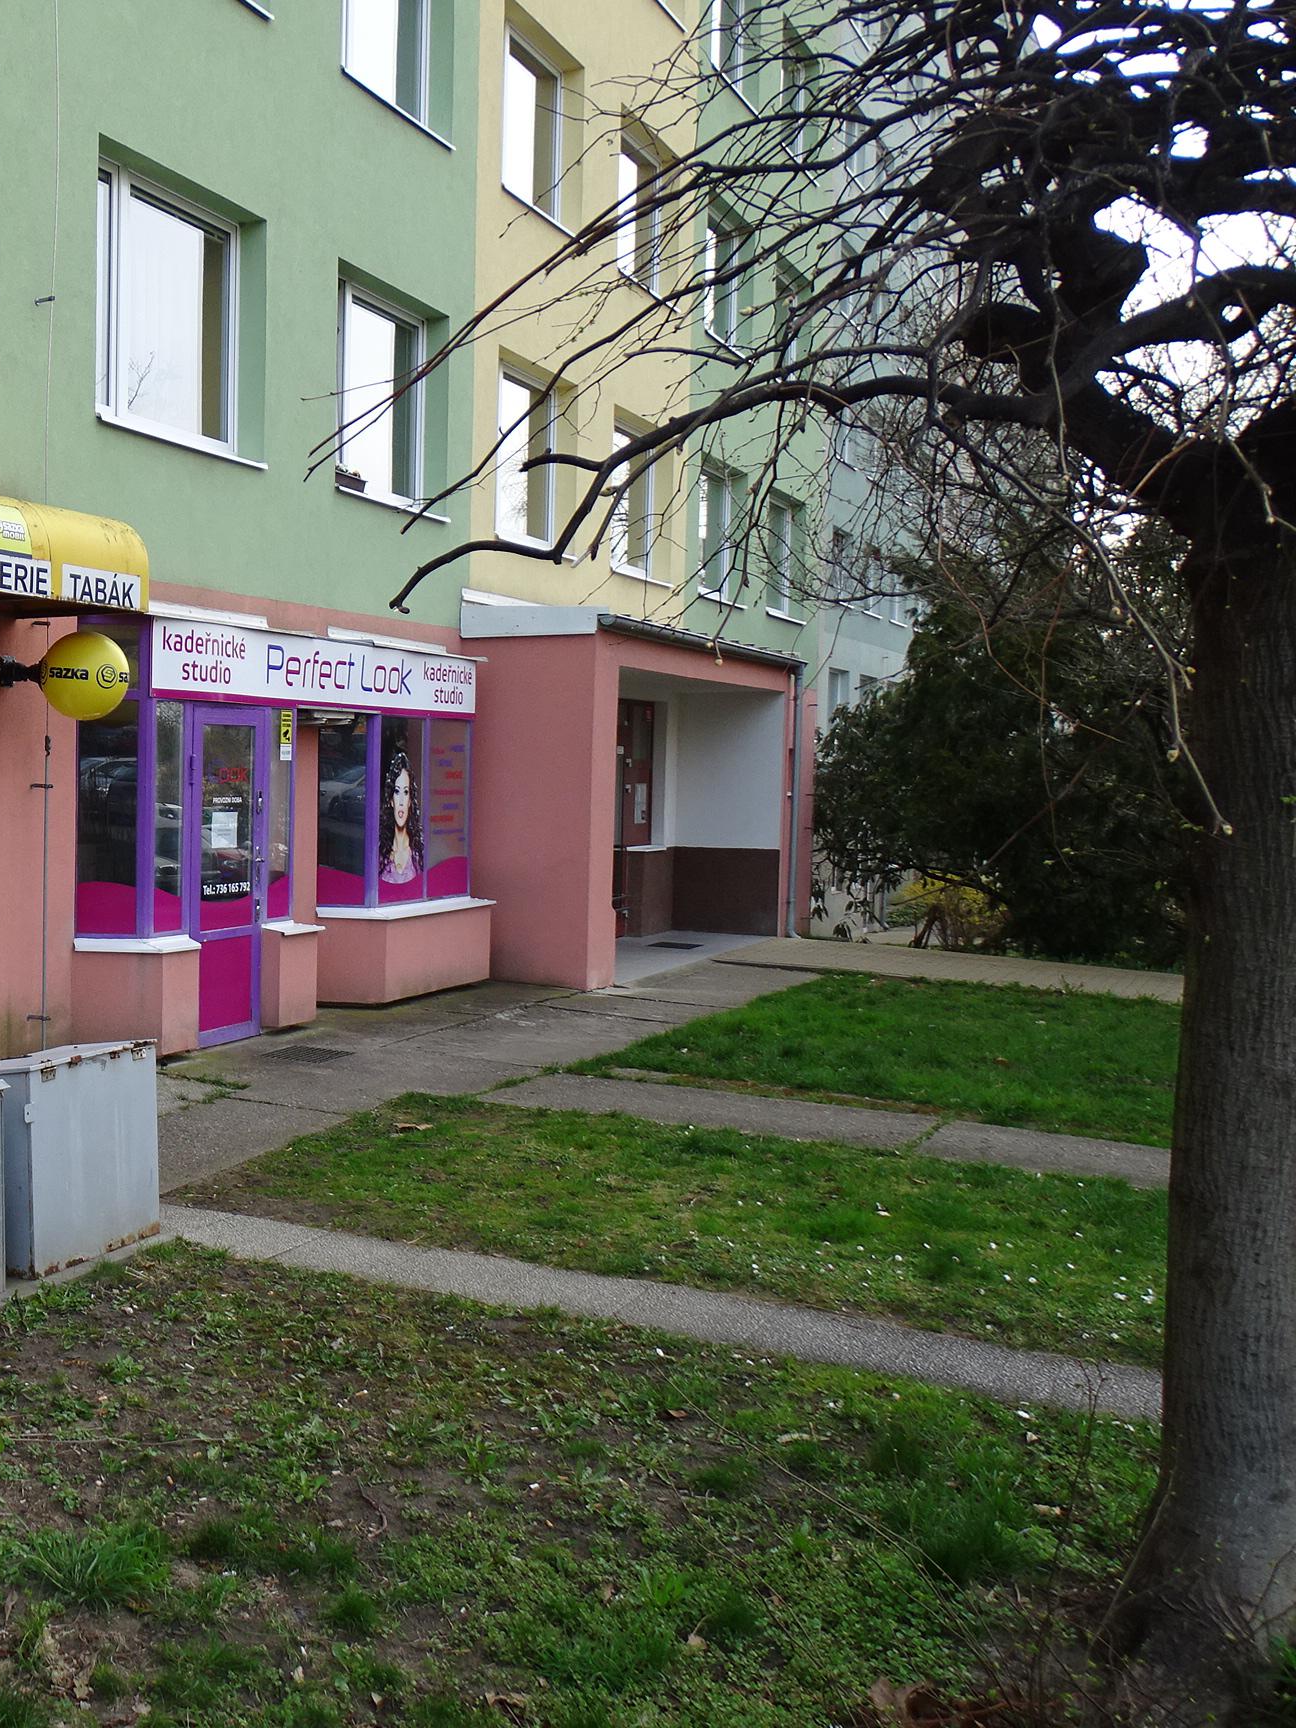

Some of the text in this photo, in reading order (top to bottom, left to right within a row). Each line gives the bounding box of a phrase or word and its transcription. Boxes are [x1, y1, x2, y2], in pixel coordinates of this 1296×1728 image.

[69, 573, 135, 609] TABÁK
[162, 625, 246, 660] kadeřnické
[48, 666, 89, 681] sazka
[181, 660, 231, 685] studio
[266, 644, 413, 696] Perfect Look
[423, 661, 473, 686] kadeřnické
[433, 686, 464, 705] studio
[216, 883, 227, 894] 736
[228, 882, 239, 893] 165
[240, 881, 251, 892] 792
